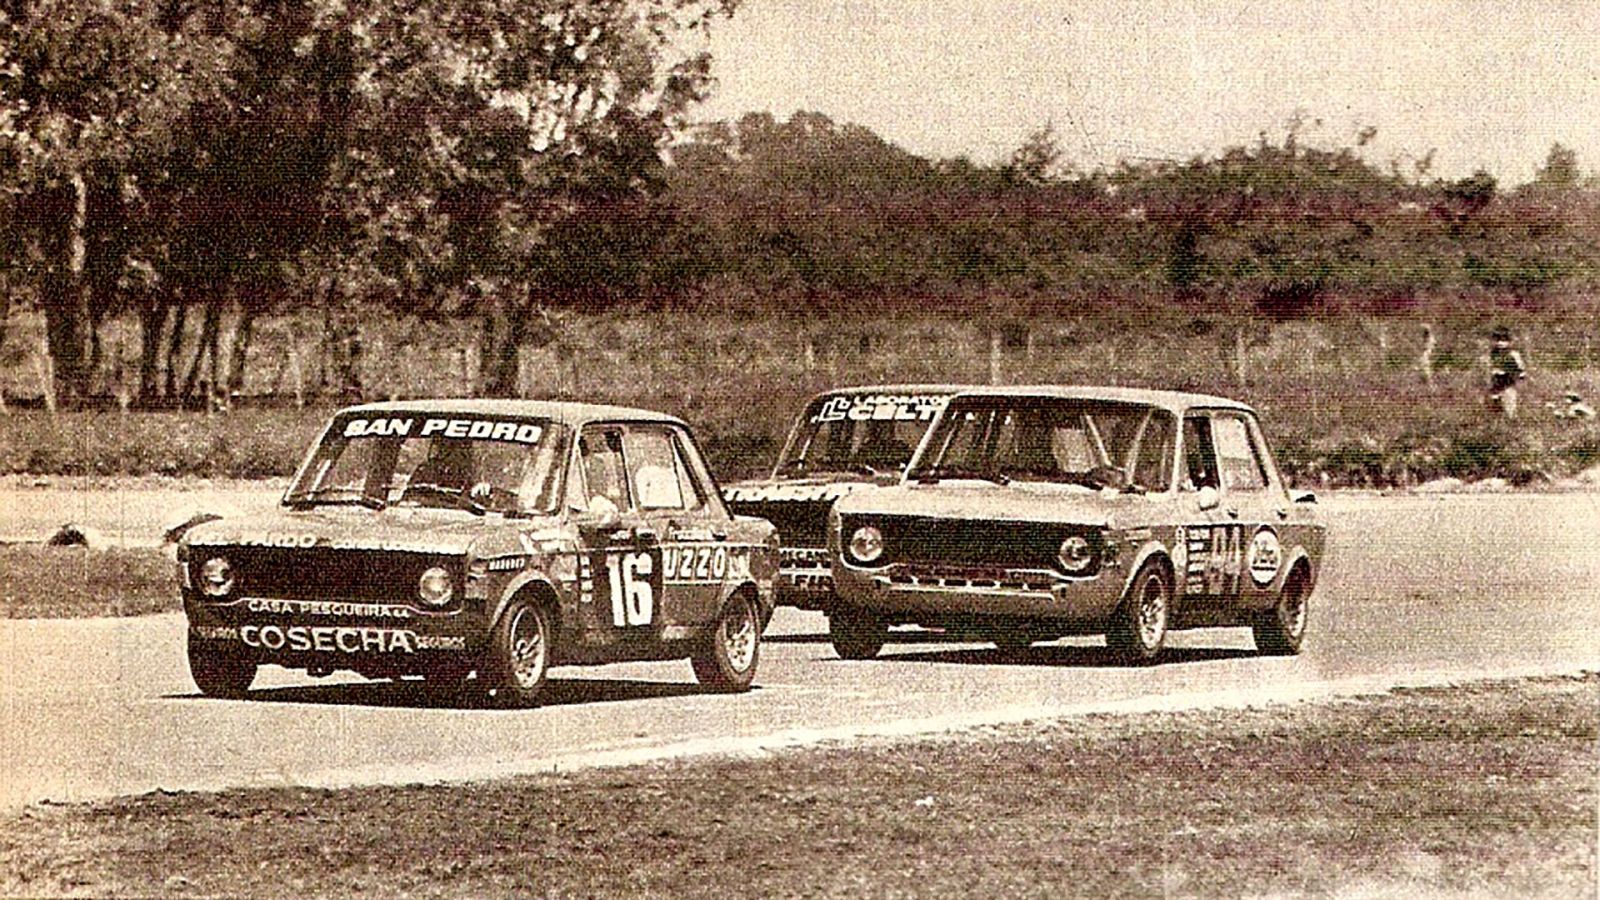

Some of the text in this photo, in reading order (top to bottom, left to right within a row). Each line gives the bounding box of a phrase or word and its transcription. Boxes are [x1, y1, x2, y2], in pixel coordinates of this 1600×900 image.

[344, 418, 542, 443] SAN PEDRO
[605, 552, 653, 627] 16
[249, 602, 293, 614] CASA
[300, 603, 391, 617] PESQUEIRA
[240, 625, 415, 653] COSECHA
